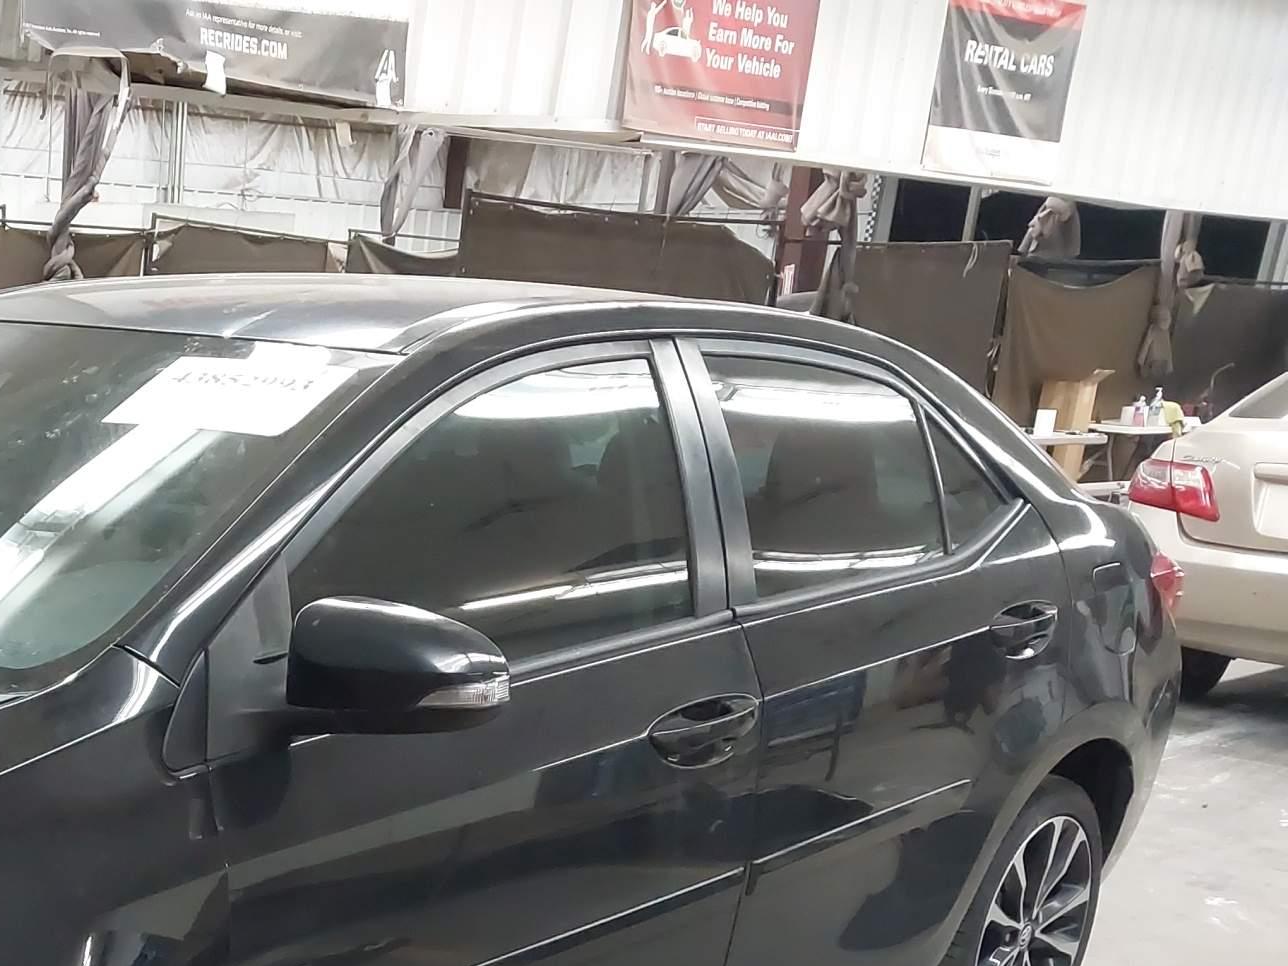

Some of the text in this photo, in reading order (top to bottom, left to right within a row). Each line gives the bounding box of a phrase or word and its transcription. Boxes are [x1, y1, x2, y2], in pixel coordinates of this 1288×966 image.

[712, 0, 789, 29] We Help You
[199, 27, 288, 60] RECRIDES.COM
[708, 22, 795, 56] Earn More For
[705, 47, 781, 79] Your Vehicle
[964, 39, 1055, 77] RENTAL CARS
